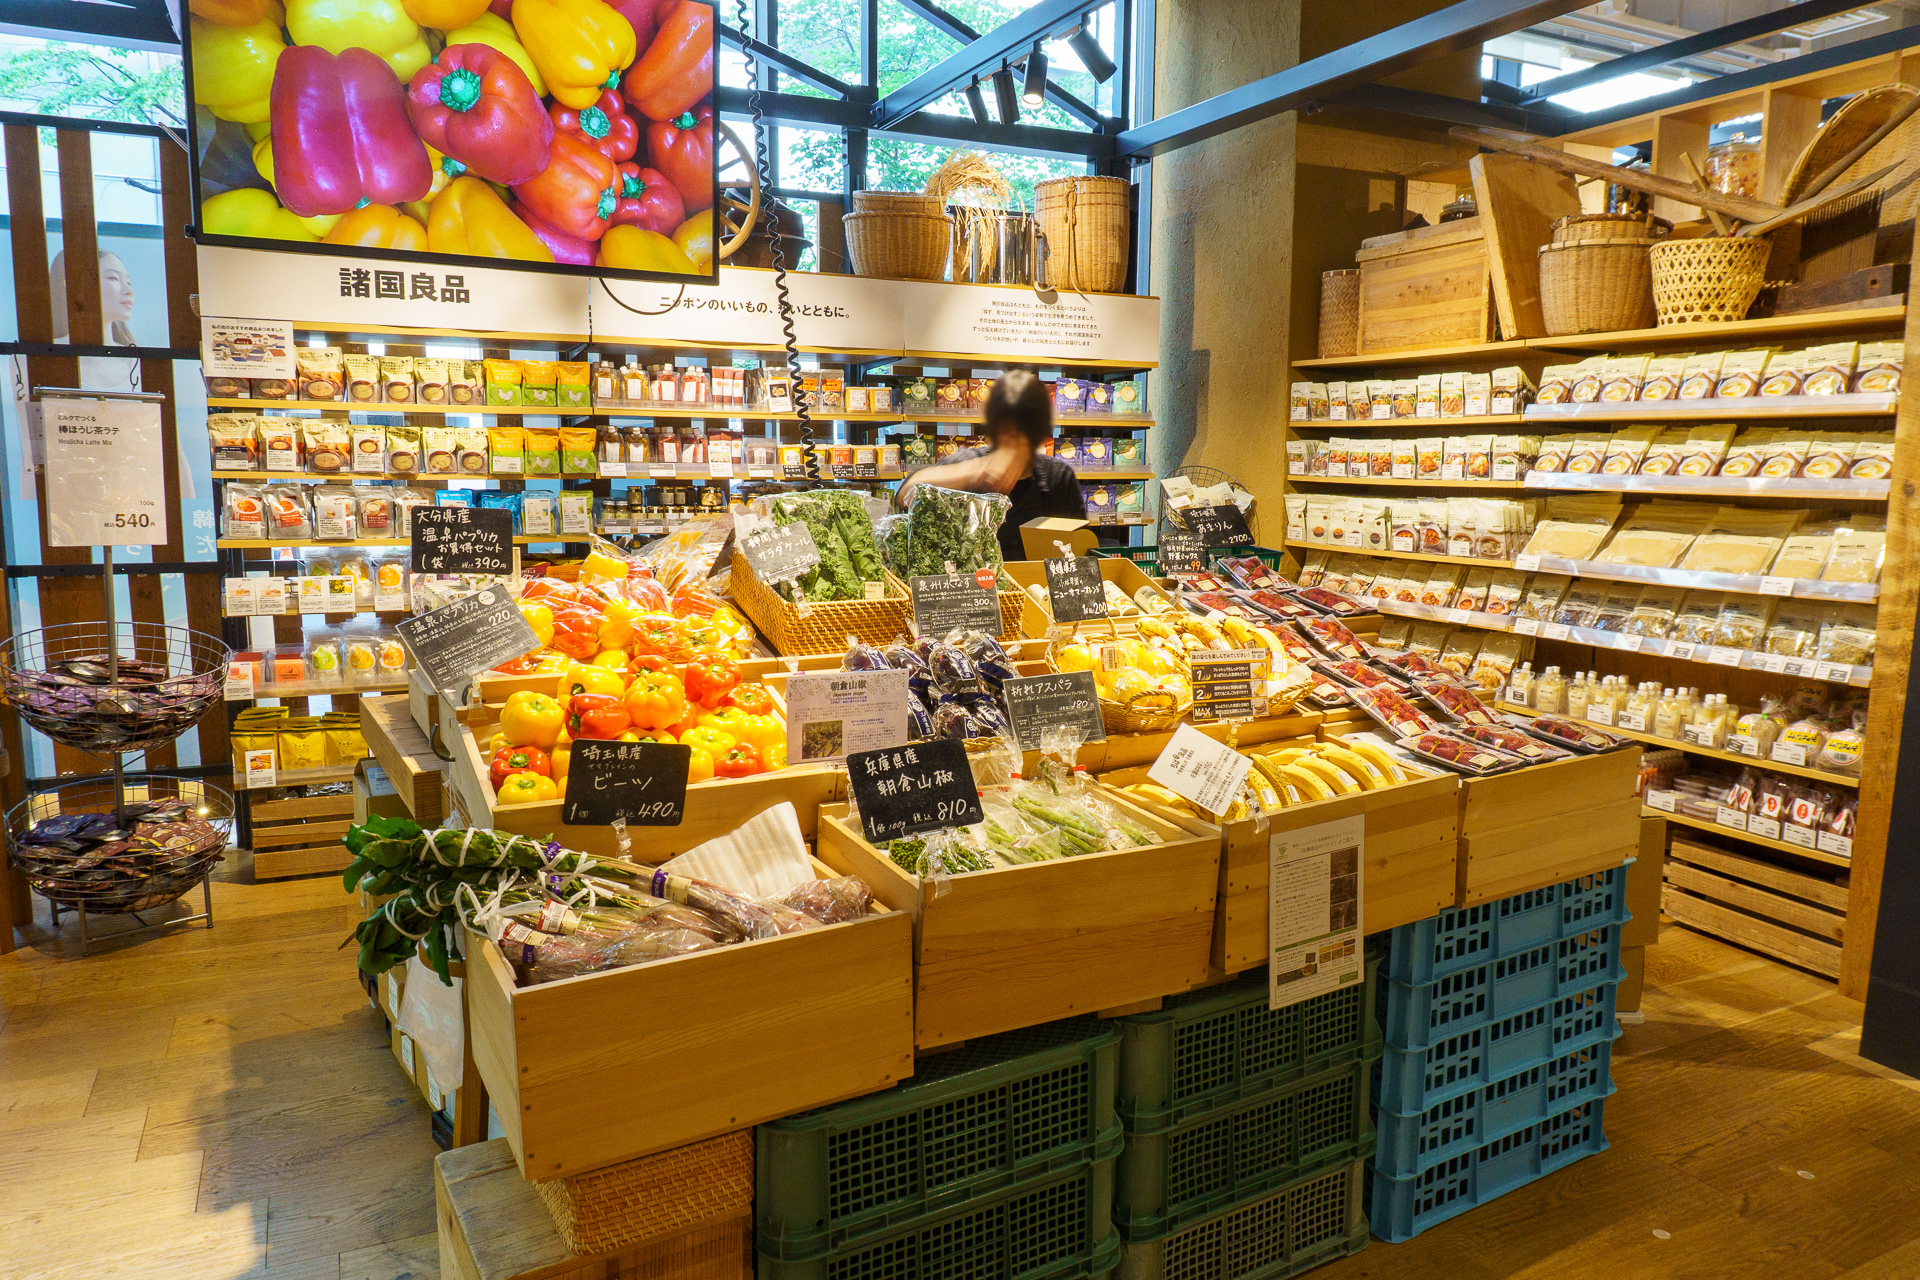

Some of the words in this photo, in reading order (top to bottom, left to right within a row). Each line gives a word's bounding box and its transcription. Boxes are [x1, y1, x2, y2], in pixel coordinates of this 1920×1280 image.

[338, 267, 471, 304] 諸国良品
[58, 425, 120, 436] 棒ほうじ茶ラテ
[58, 438, 84, 446] Houjicha
[416, 507, 471, 525] 大分県産
[422, 526, 498, 543] 温泉パプリカ
[437, 541, 503, 555] お買得セット
[757, 536, 811, 561] サラダケール
[918, 577, 971, 592] 泉州水なす
[830, 679, 867, 691] 朝倉山椒
[1010, 678, 1073, 697] 折れアスパラ
[1196, 689, 1205, 700] 2
[1194, 707, 1211, 717] MAX
[581, 744, 643, 761] 埼玉県産
[864, 747, 920, 777] 兵庫県産
[594, 772, 653, 791] ビーツ
[876, 769, 955, 797] 朝倉山椒
